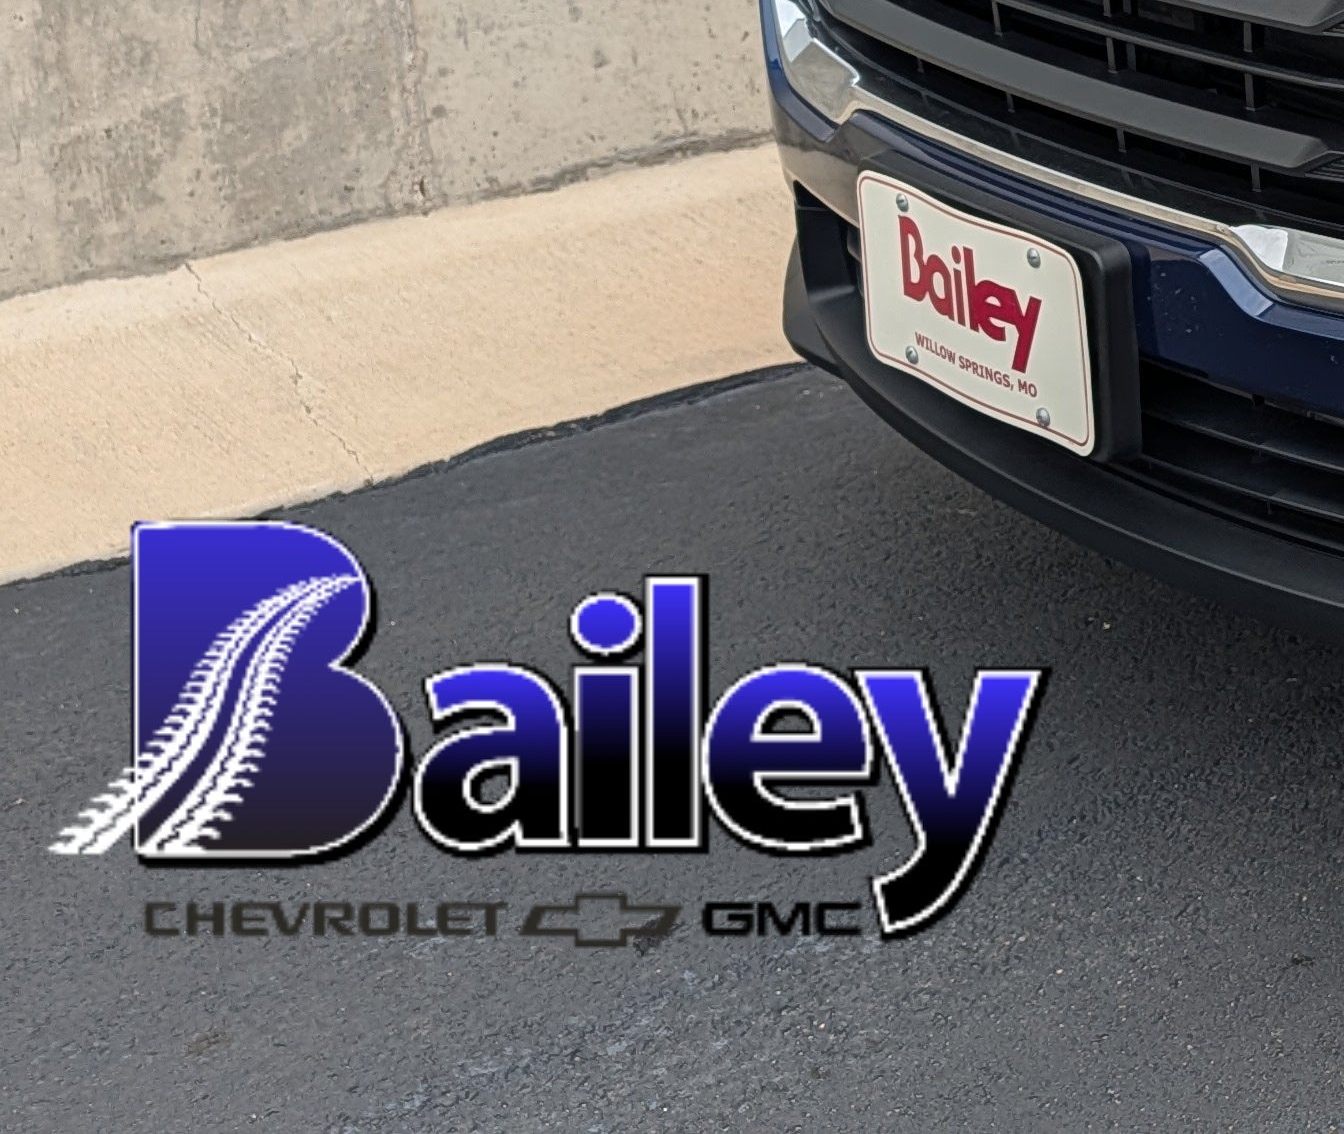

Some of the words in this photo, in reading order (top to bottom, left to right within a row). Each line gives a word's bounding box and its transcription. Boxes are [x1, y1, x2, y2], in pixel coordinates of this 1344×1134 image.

[897, 214, 1043, 374] Bailey
[914, 331, 957, 365] WILLOW
[958, 355, 1015, 392] SPRINGS,
[1017, 378, 1039, 398] MO
